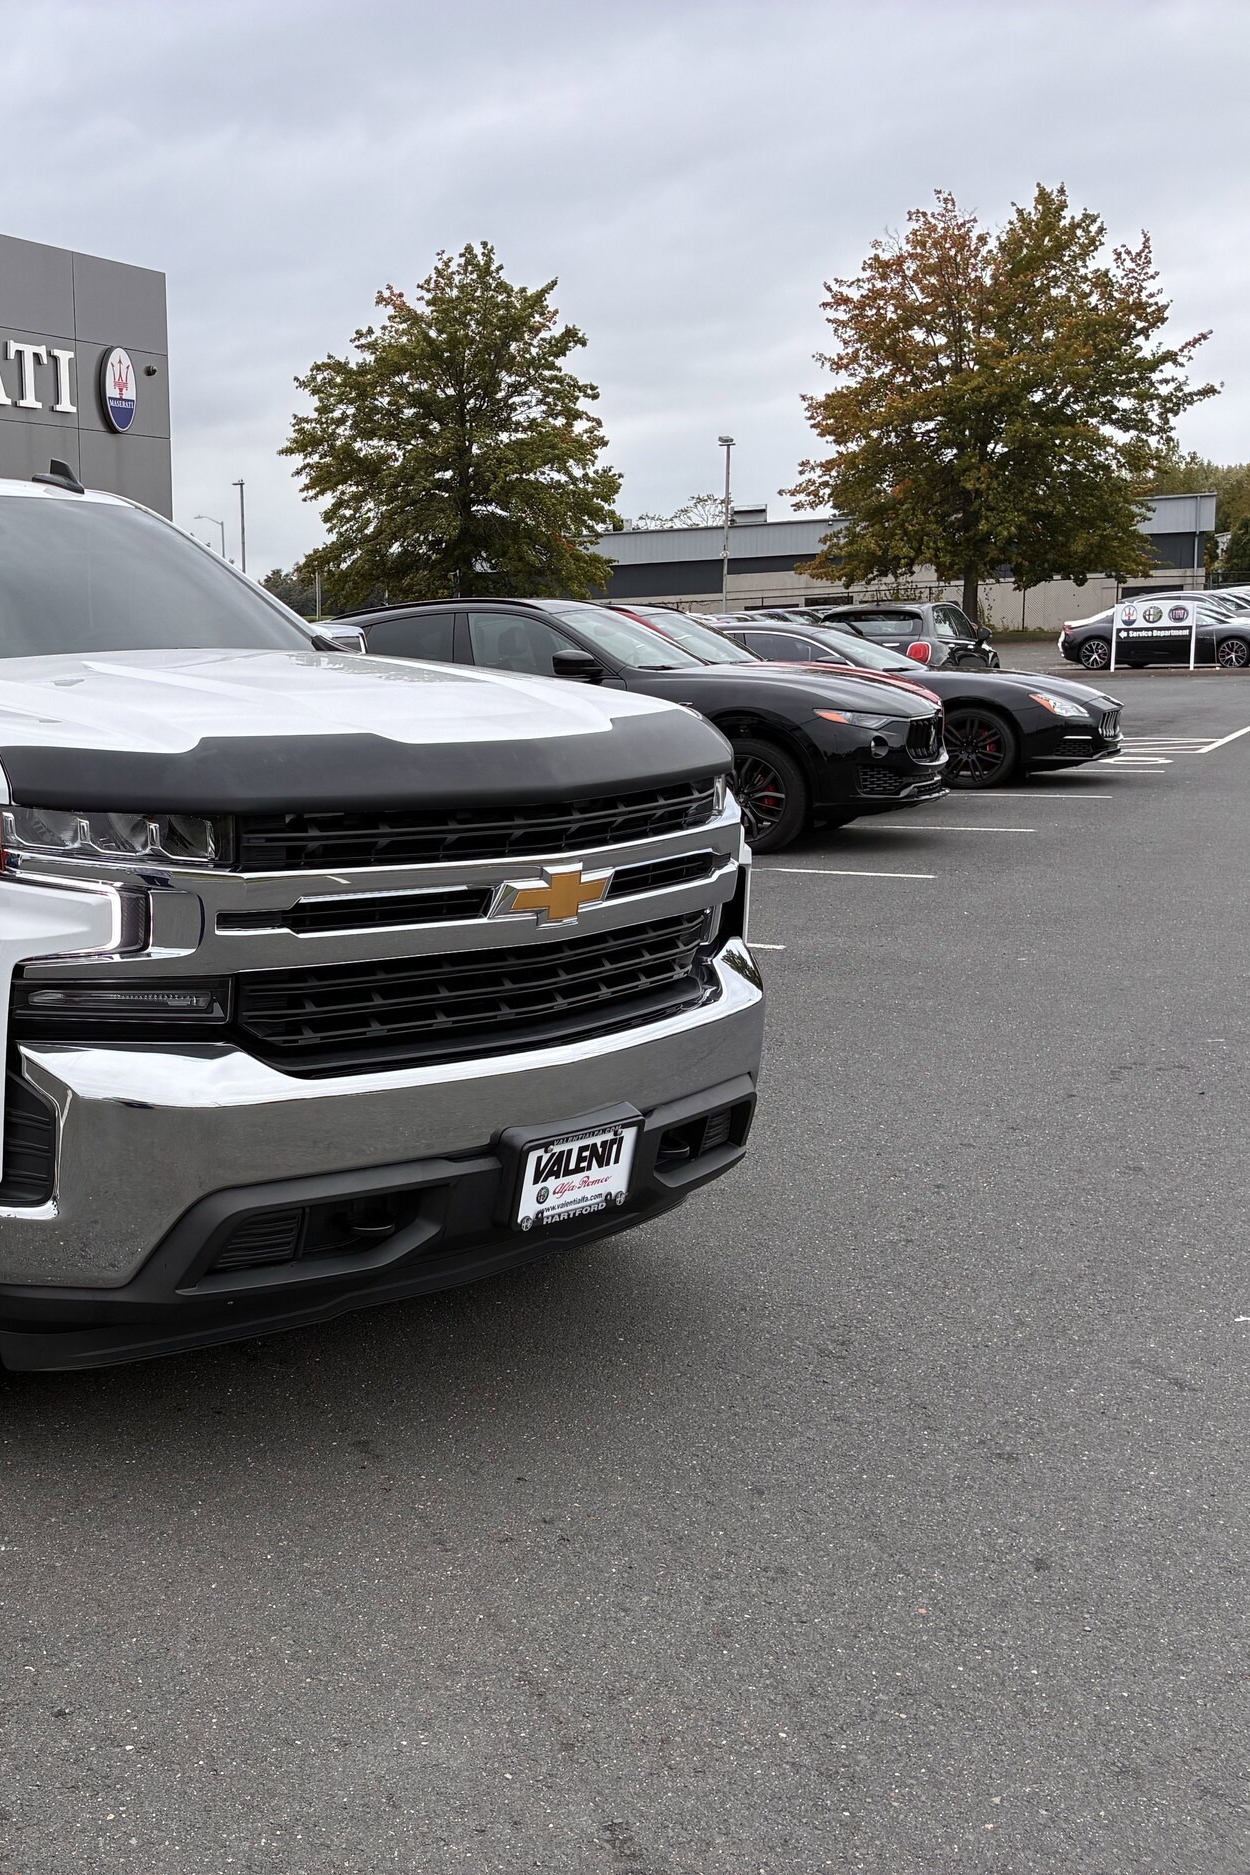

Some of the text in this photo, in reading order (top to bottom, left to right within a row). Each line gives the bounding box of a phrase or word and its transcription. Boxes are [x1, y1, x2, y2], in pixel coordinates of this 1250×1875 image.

[110, 399, 134, 409] MASERATI
[1129, 629, 1190, 638] Service Department
[532, 1135, 625, 1186] VALENTI
[552, 1175, 612, 1200] Alfa Romeo
[542, 1202, 607, 1225] HARTFORD
